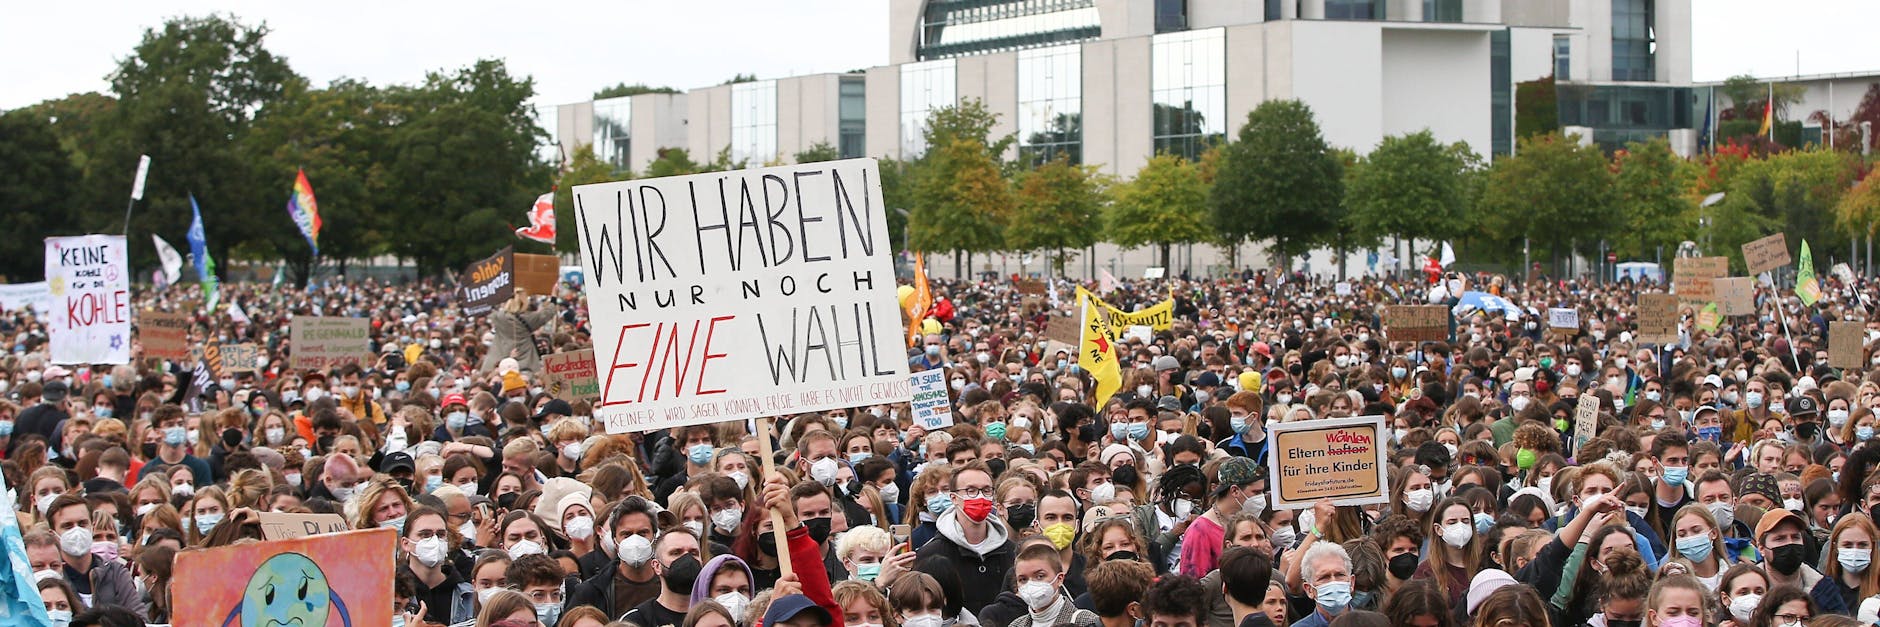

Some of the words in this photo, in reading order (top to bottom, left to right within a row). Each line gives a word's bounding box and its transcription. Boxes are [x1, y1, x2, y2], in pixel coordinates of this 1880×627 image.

[577, 185, 677, 288] WIR
[689, 168, 873, 275] HABEN
[61, 245, 108, 266] KEINE
[68, 290, 126, 330] KOHLE
[618, 285, 705, 312] NUR
[742, 271, 873, 299] NOCH
[603, 315, 735, 406] EINE
[756, 302, 895, 386] WAHL
[610, 409, 656, 428] KEINER
[664, 406, 686, 421] WIRD
[690, 402, 719, 419] SAGEN
[800, 390, 820, 407] HABE
[825, 389, 835, 404] ES
[839, 384, 864, 403] NICHT
[925, 417, 942, 427] TOO
[1283, 465, 1301, 477] für
[1305, 463, 1329, 475] ihre
[1333, 459, 1373, 472] Kinder
[1288, 447, 1325, 459] Eltern
